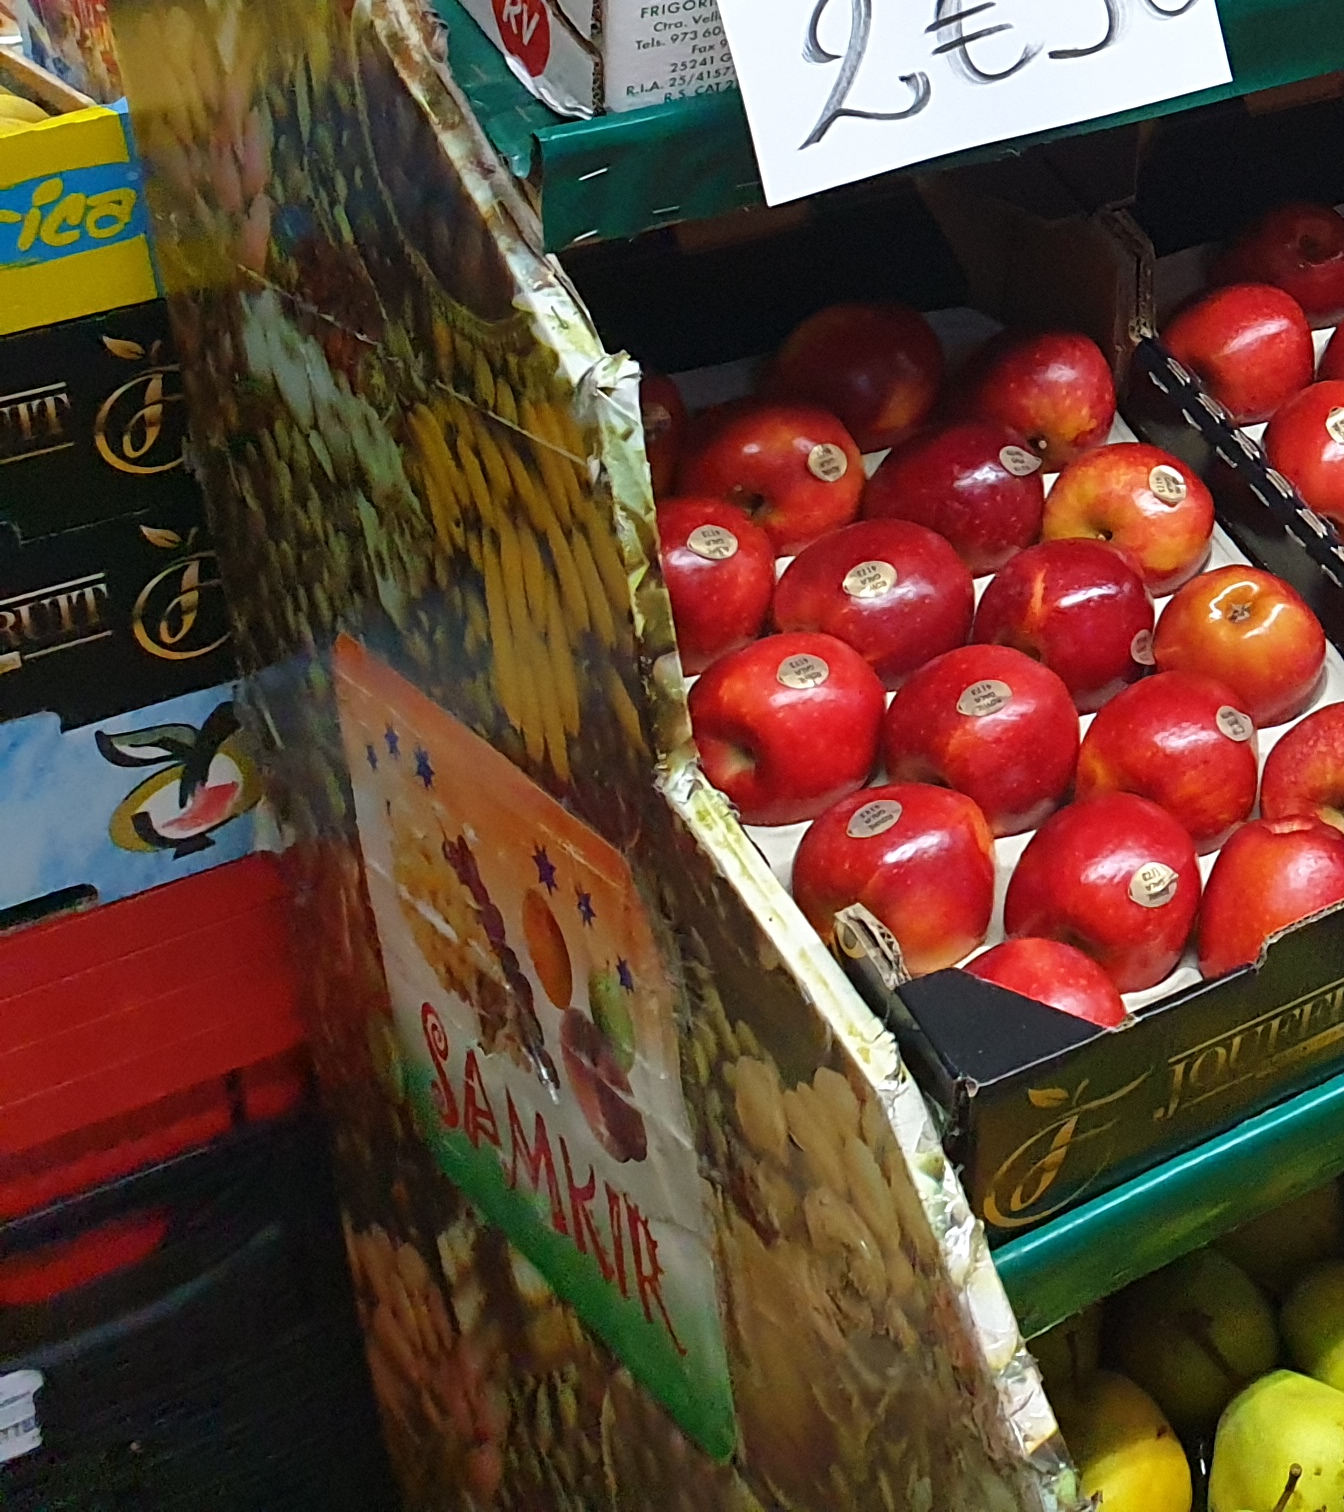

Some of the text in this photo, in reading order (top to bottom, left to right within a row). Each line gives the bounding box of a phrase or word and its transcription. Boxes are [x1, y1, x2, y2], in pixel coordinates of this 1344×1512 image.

[692, 10, 721, 25] Vell
[670, 30, 698, 44] 973
[691, 42, 714, 54] Fax
[670, 55, 714, 73] 25241
[0, 176, 137, 252] ica
